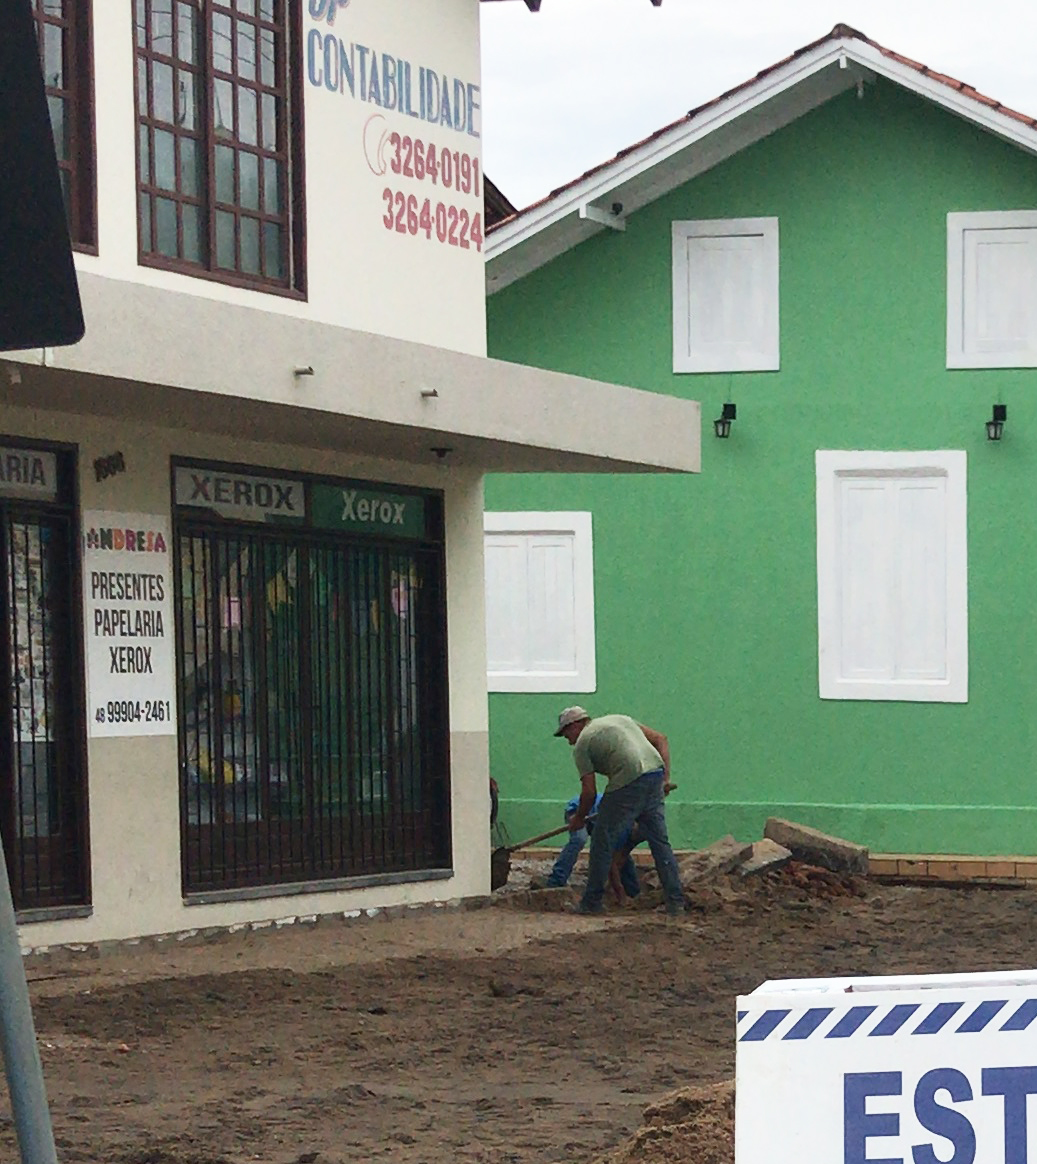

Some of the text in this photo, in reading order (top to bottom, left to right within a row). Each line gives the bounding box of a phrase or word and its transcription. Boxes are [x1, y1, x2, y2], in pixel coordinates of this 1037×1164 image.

[307, 28, 481, 138] CONTABILIDADE
[390, 131, 480, 198] 3264-0191
[382, 187, 483, 253] 3264-0224
[190, 474, 295, 511] XEROX
[341, 489, 404, 525] Xerox
[91, 571, 165, 602] PRESENTES
[94, 608, 164, 637] PAPELARIA
[109, 646, 153, 674] XEROX
[107, 700, 171, 724] 99904-2461
